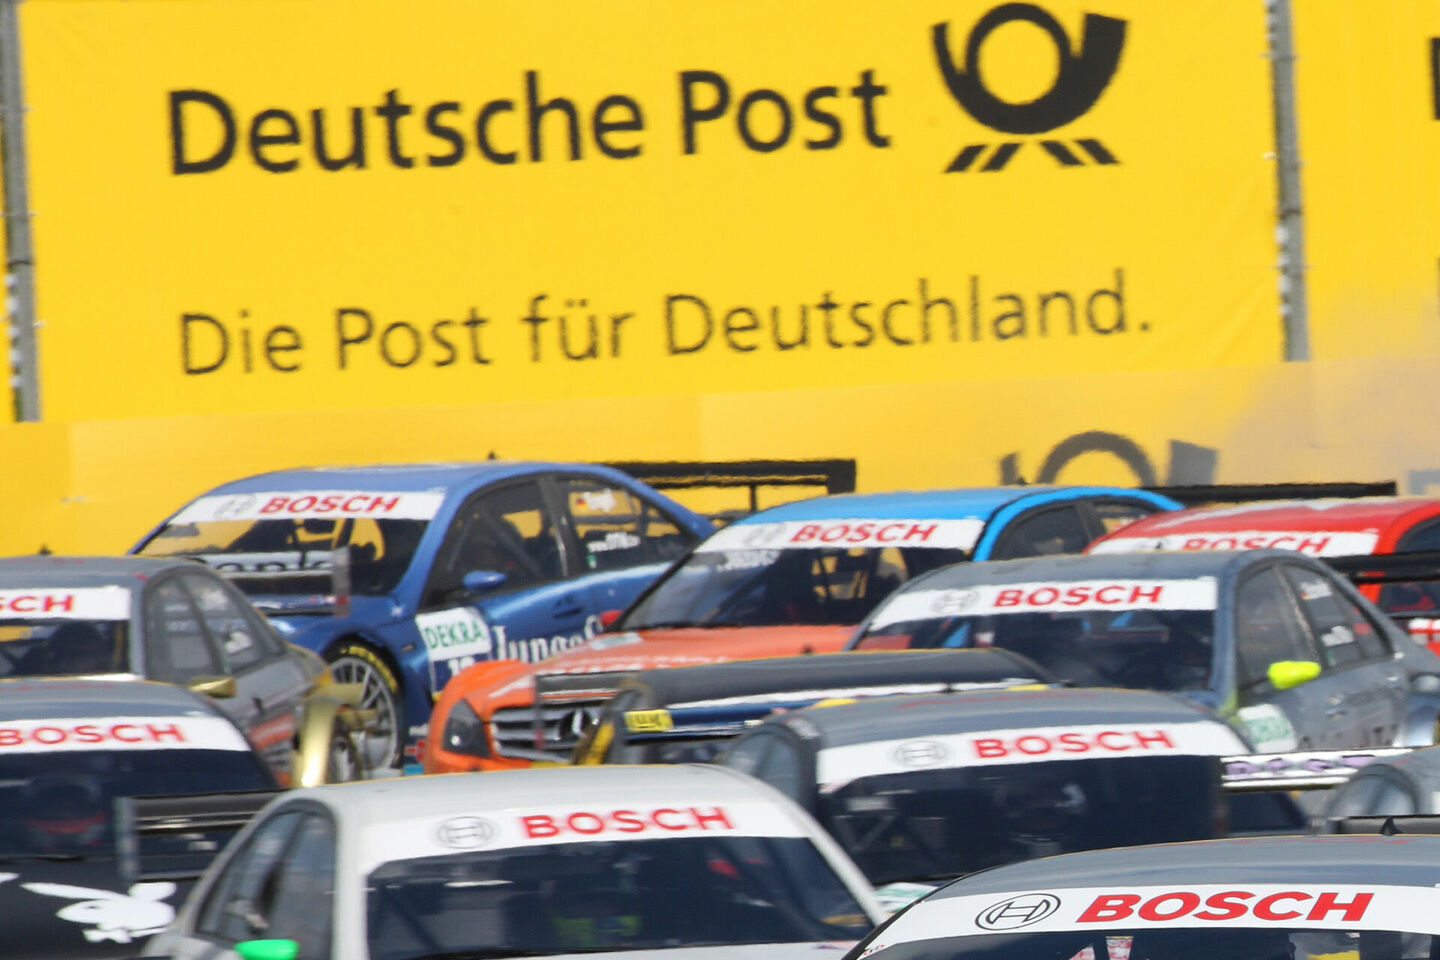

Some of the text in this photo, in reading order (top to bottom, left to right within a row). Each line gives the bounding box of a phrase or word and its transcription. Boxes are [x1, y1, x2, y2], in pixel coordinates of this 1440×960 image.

[166, 69, 891, 176] Deutsche Post
[179, 268, 1151, 377] Die Post für Deutschland.
[257, 495, 402, 515] BOSCH
[789, 522, 938, 544] BOSCH
[1181, 536, 1333, 552] BOSCH
[0, 594, 75, 612] CH
[992, 584, 1165, 608] BOSCH
[423, 620, 486, 650] DEKRA
[0, 723, 188, 747] BOSCH
[971, 729, 1178, 760] BOSCH
[518, 806, 738, 839] BOSCH
[1076, 891, 1376, 923] BOSCH
